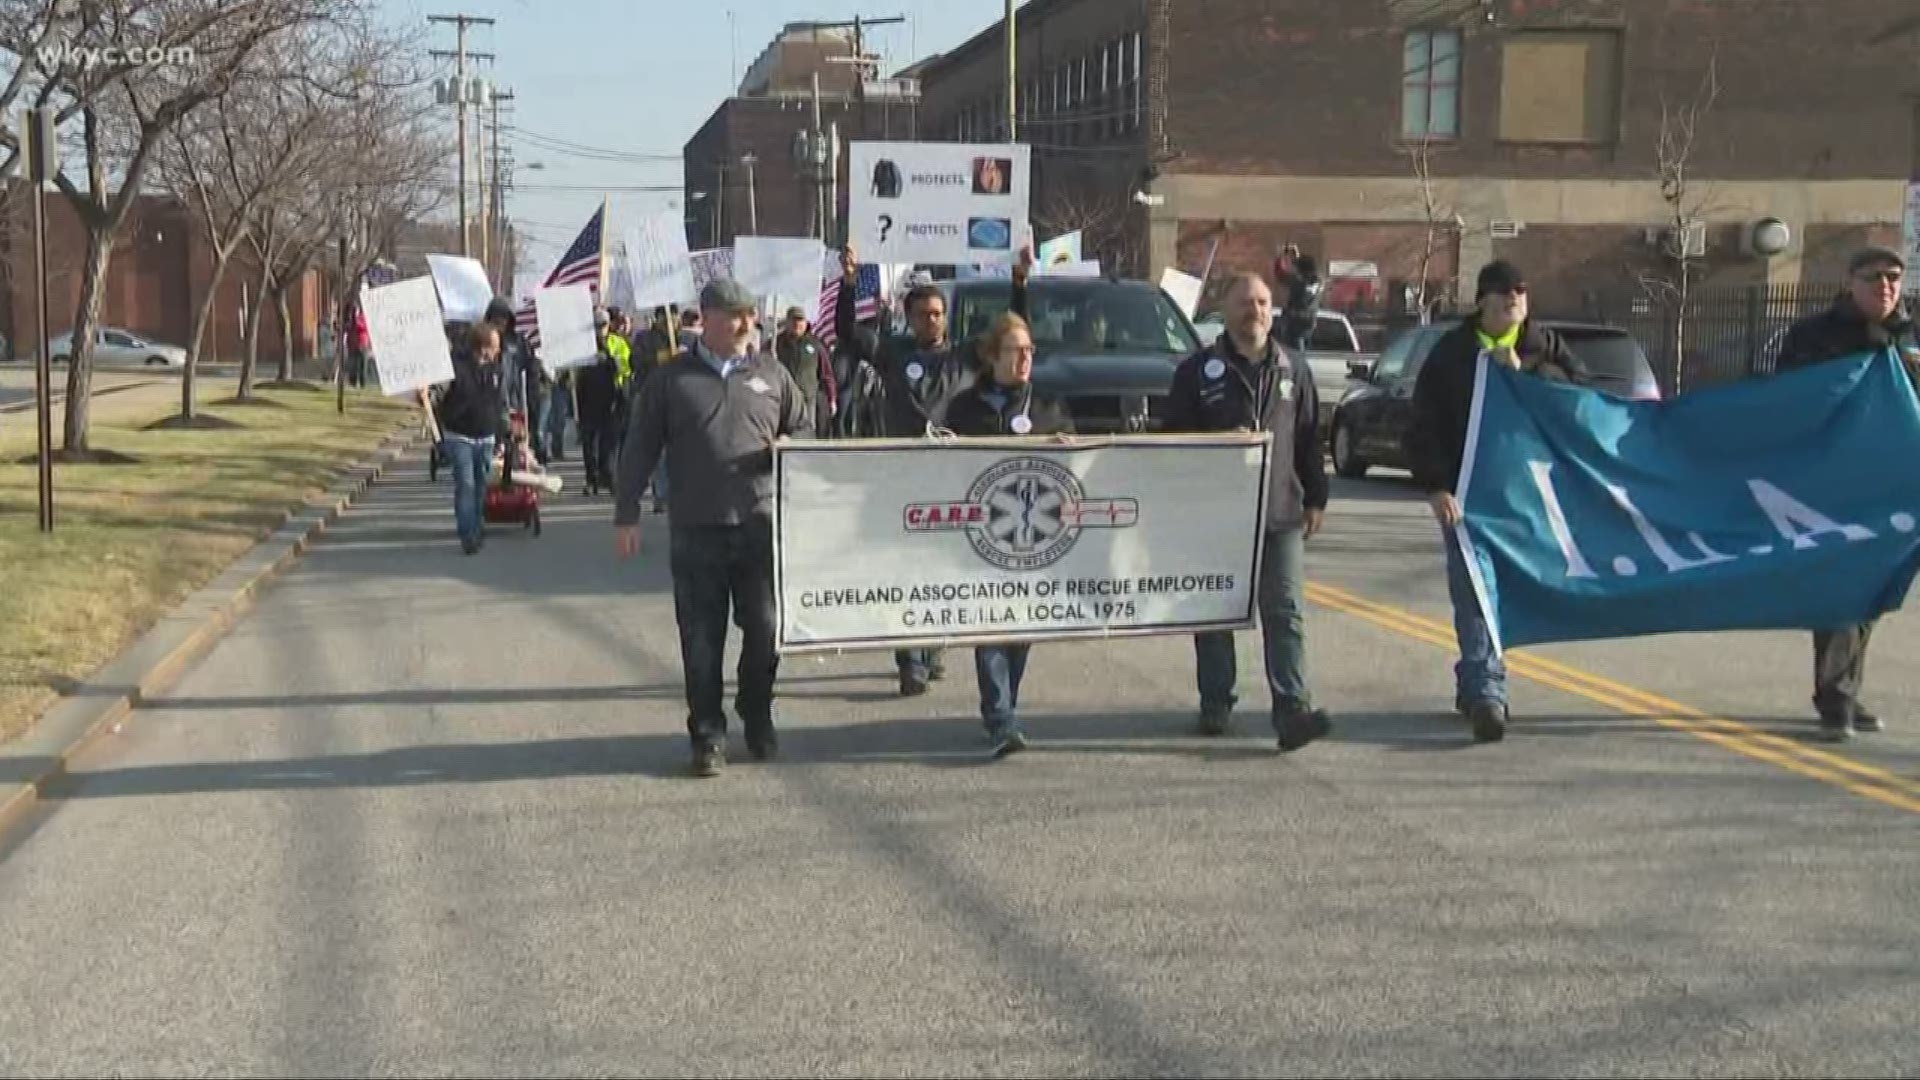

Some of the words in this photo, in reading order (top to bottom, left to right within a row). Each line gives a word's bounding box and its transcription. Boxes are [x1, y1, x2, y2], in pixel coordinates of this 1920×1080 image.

[911, 173, 965, 187] PROTECTS
[905, 224, 959, 237] PROTECTS
[1527, 459, 1916, 578] I.L.A.
[800, 586, 904, 608] CLEVELAND
[909, 581, 1029, 602] ASSOCIATION
[1035, 580, 1060, 597] OF
[1066, 577, 1131, 596] RESCUE
[1138, 574, 1234, 594] EMPLOYEES
[1027, 603, 1085, 621] LOCAL
[1094, 600, 1135, 620] 1975
